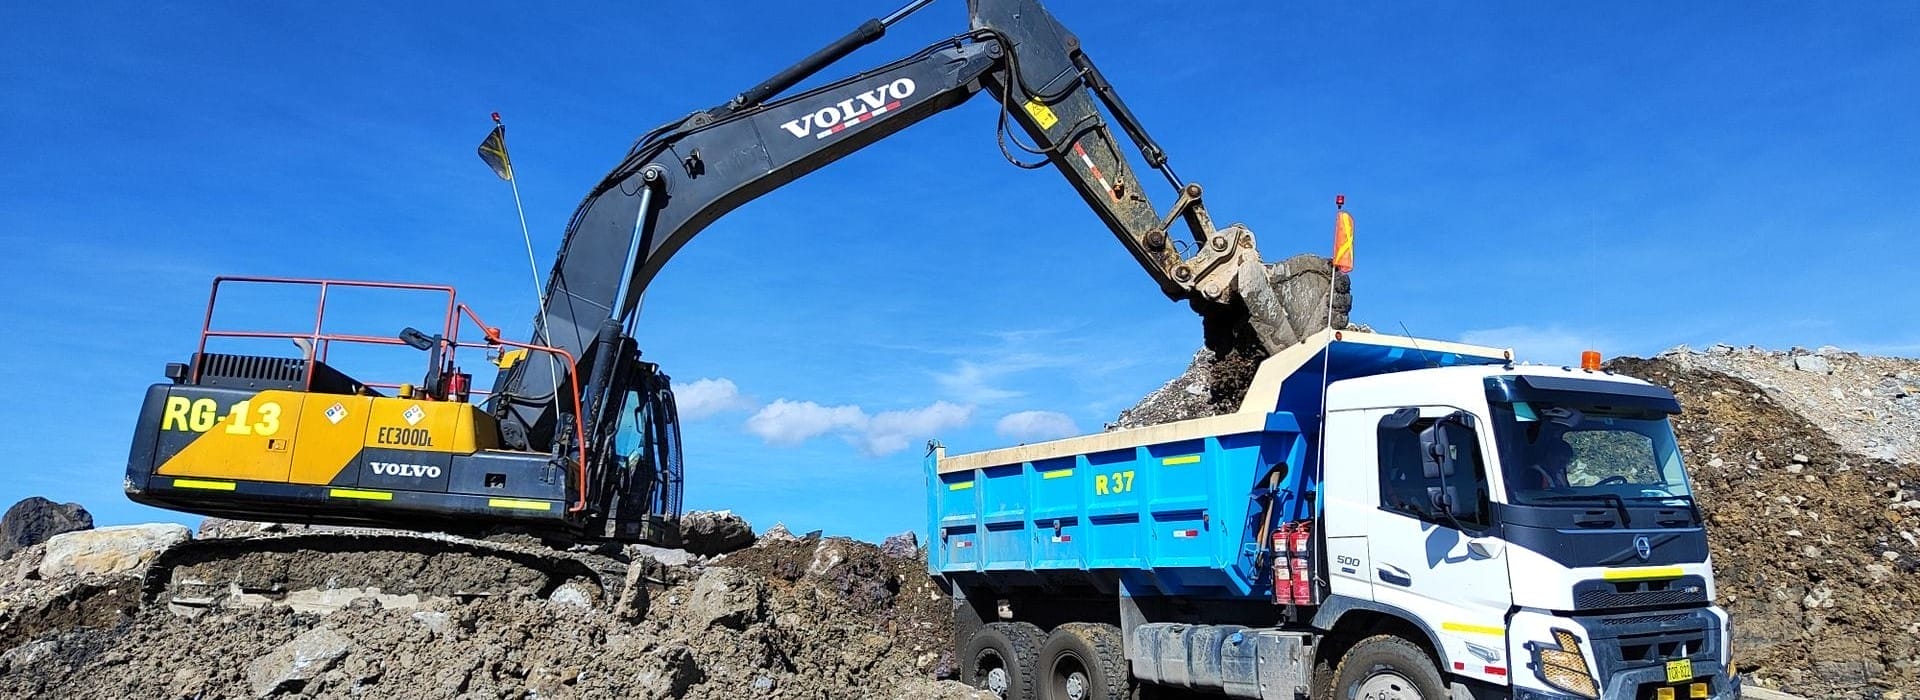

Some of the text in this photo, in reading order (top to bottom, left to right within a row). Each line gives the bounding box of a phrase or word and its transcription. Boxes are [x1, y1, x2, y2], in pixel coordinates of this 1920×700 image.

[780, 78, 916, 138] VOLVO
[162, 396, 281, 436] RG-13
[370, 462, 441, 478] VOLVO
[1095, 471, 1134, 495] R 37
[1337, 555, 1360, 566] 500
